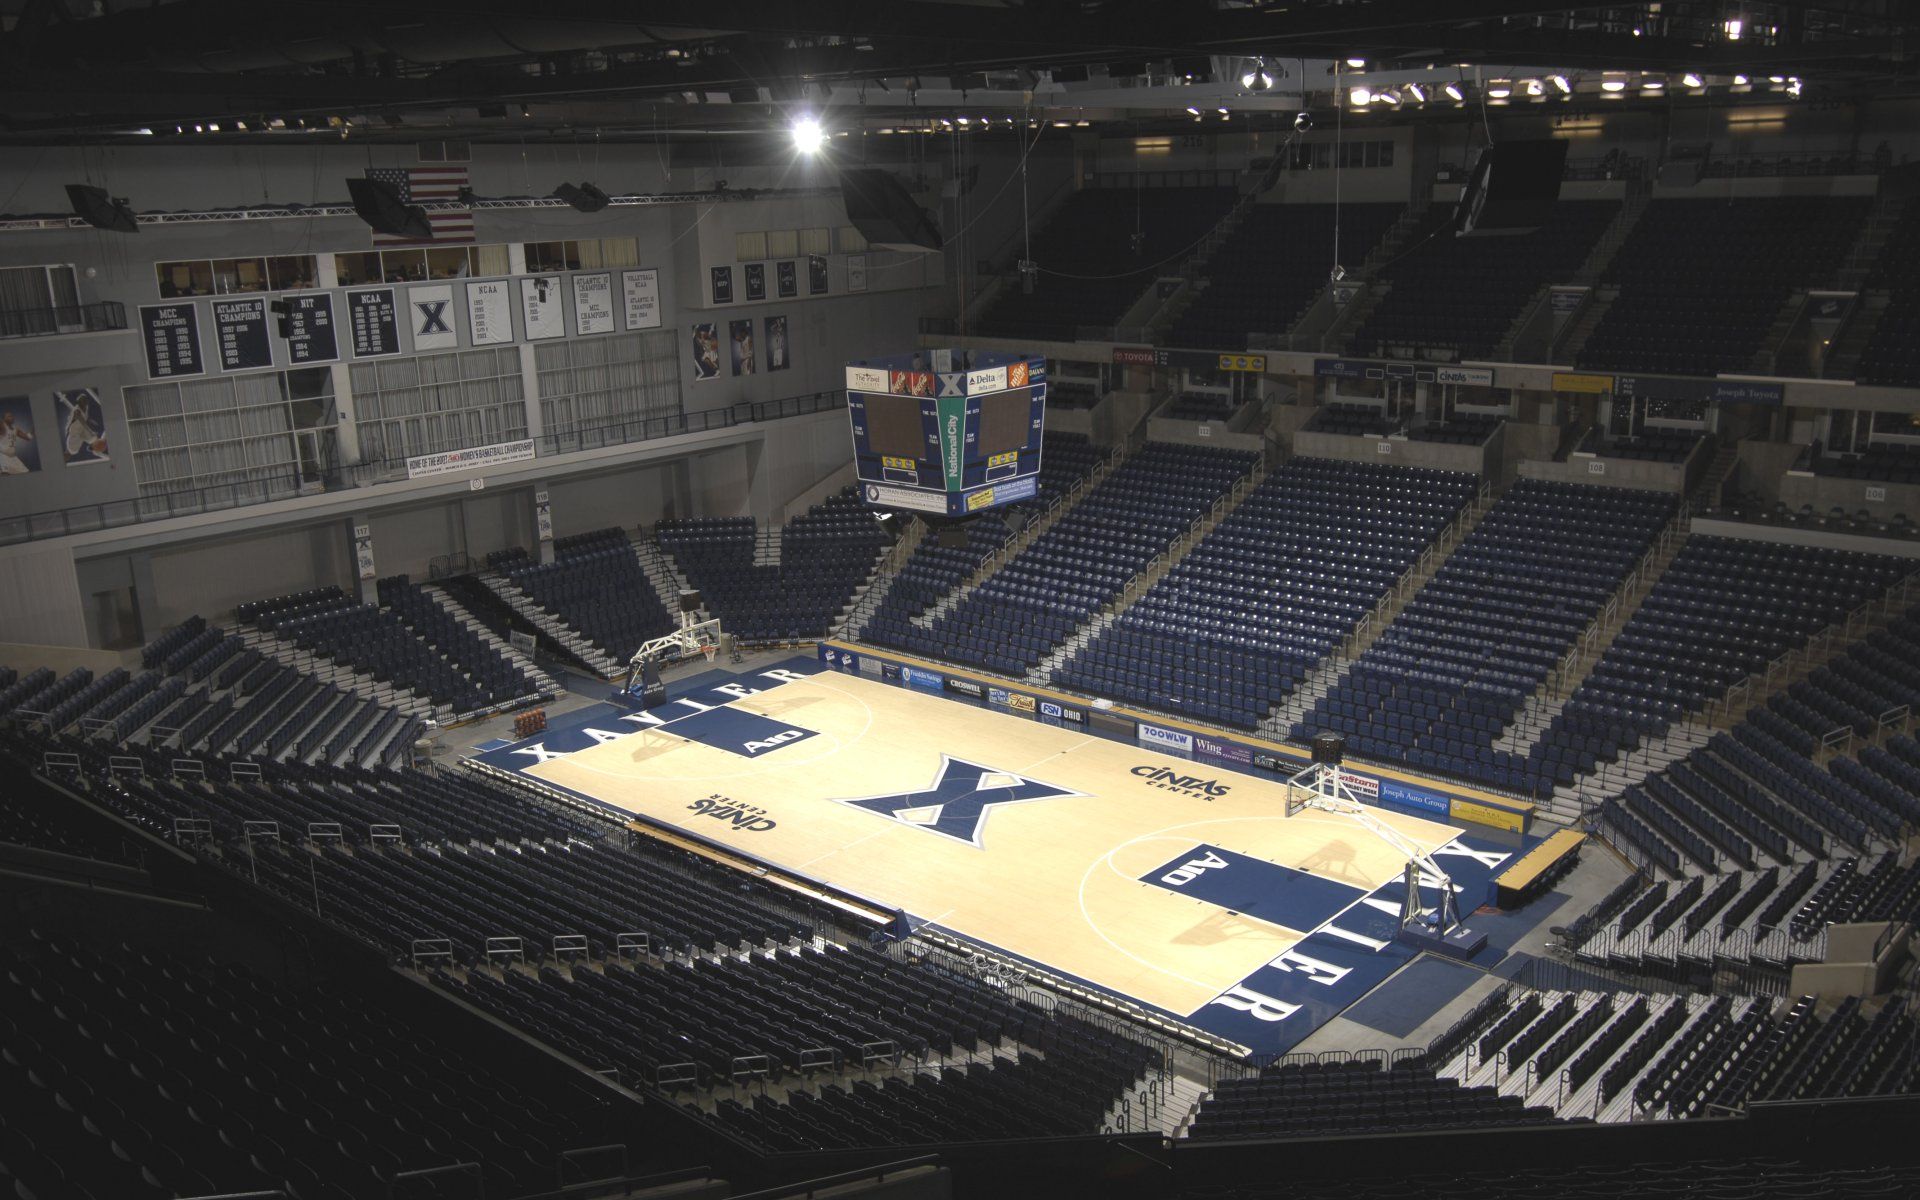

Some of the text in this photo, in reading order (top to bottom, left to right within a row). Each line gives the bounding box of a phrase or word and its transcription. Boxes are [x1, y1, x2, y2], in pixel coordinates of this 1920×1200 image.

[576, 277, 601, 286] ATLANTIC
[579, 283, 608, 292] CHAMPIONS
[478, 285, 498, 295] NCAA
[300, 298, 315, 309] NIT
[361, 294, 381, 304] NCAA
[159, 308, 178, 319] MCC
[217, 302, 263, 314] ATLANTIC 10
[219, 311, 261, 323] CHAMPIONS
[581, 311, 610, 320] CHAMPIONS
[153, 318, 187, 328] CHAMPIONS
[1124, 352, 1154, 362] TOYOTA
[855, 373, 865, 382] The
[976, 374, 996, 385] Delta
[1716, 387, 1780, 400] Joseph Toyota
[1379, 444, 1390, 452] 110
[409, 459, 421, 470] HOME
[421, 458, 428, 468] OF
[428, 457, 436, 467] THE
[436, 455, 448, 466] 2007
[460, 449, 479, 461] WOMEN'S
[479, 446, 504, 459] BASKETBALL
[504, 441, 533, 454] CHAMPIONSHIP
[1590, 464, 1603, 472] 108
[910, 669, 927, 679] Franklin
[950, 679, 980, 693] CROSWELL
[510, 669, 810, 762] XAVIER
[1043, 703, 1081, 721] FSN OHIO
[1143, 726, 1187, 744] 700WLW
[742, 730, 803, 754] A10
[1196, 738, 1222, 756] Wing
[1131, 766, 1231, 796] CINTAS
[1146, 781, 1216, 802] CENTER
[1363, 787, 1377, 796] WORK
[1382, 786, 1447, 809] Joseph Auto Group
[710, 794, 767, 815] CENTER
[825, 752, 1096, 851] X
[686, 799, 777, 831] CINTAS
[1161, 851, 1230, 885] A10
